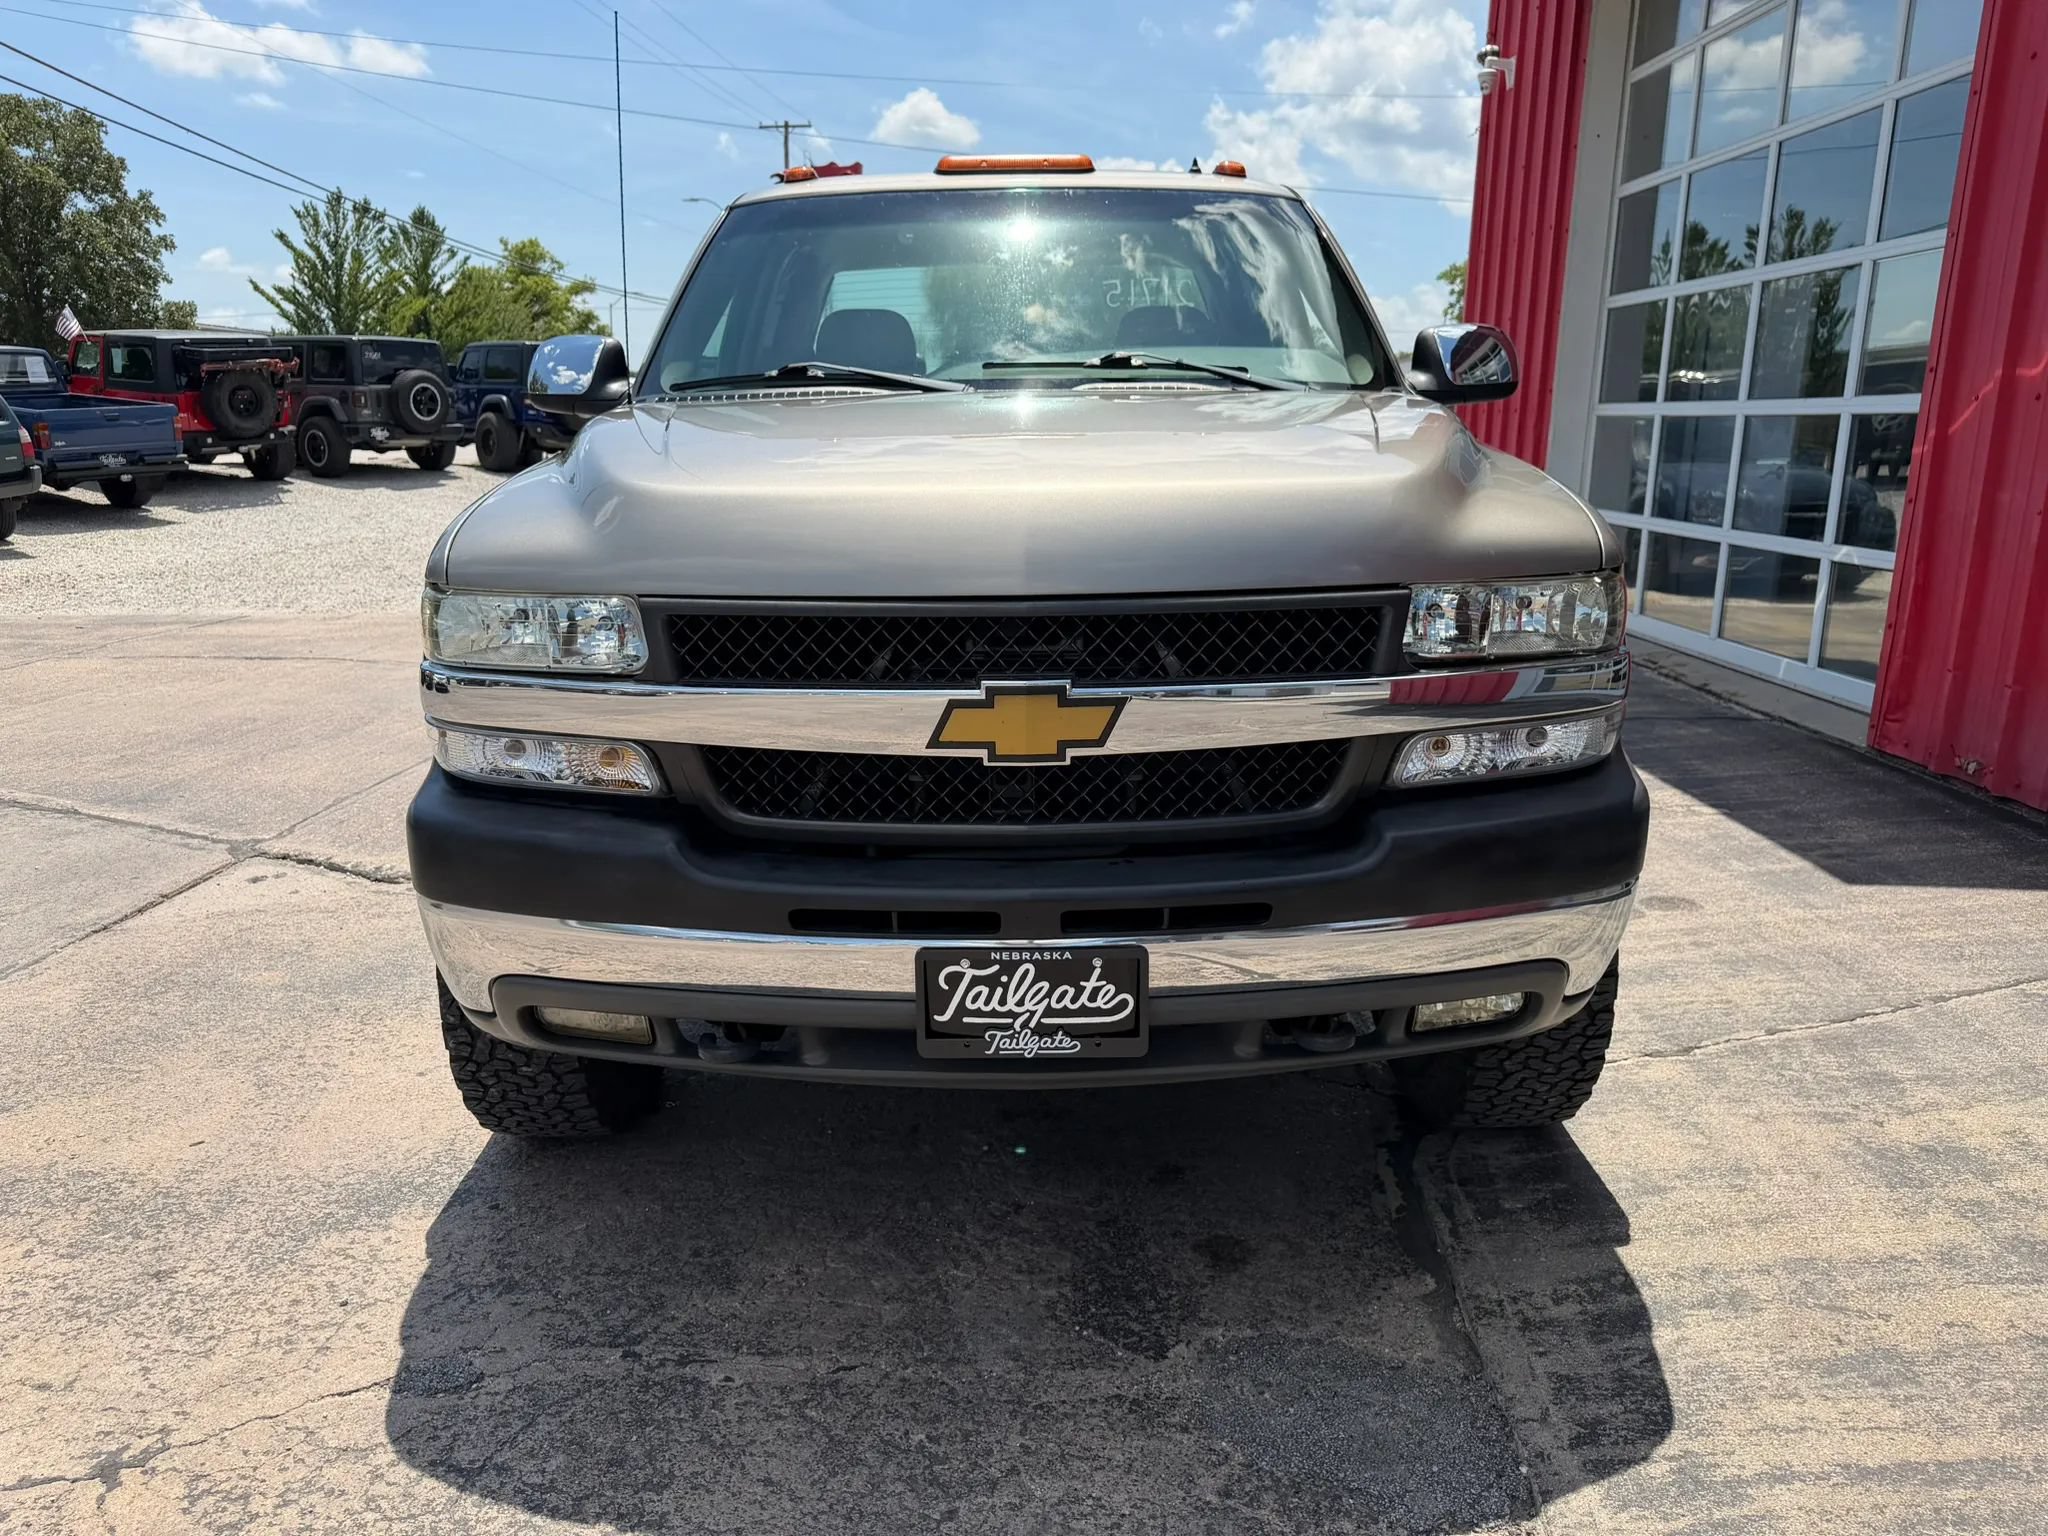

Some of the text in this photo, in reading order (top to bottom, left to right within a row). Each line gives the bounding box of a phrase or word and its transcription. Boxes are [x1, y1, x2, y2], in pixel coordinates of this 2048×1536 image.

[991, 951, 1072, 960] NEBRASKA
[933, 962, 1134, 1031] Tailgate
[984, 1028, 1081, 1058] Tailgate
